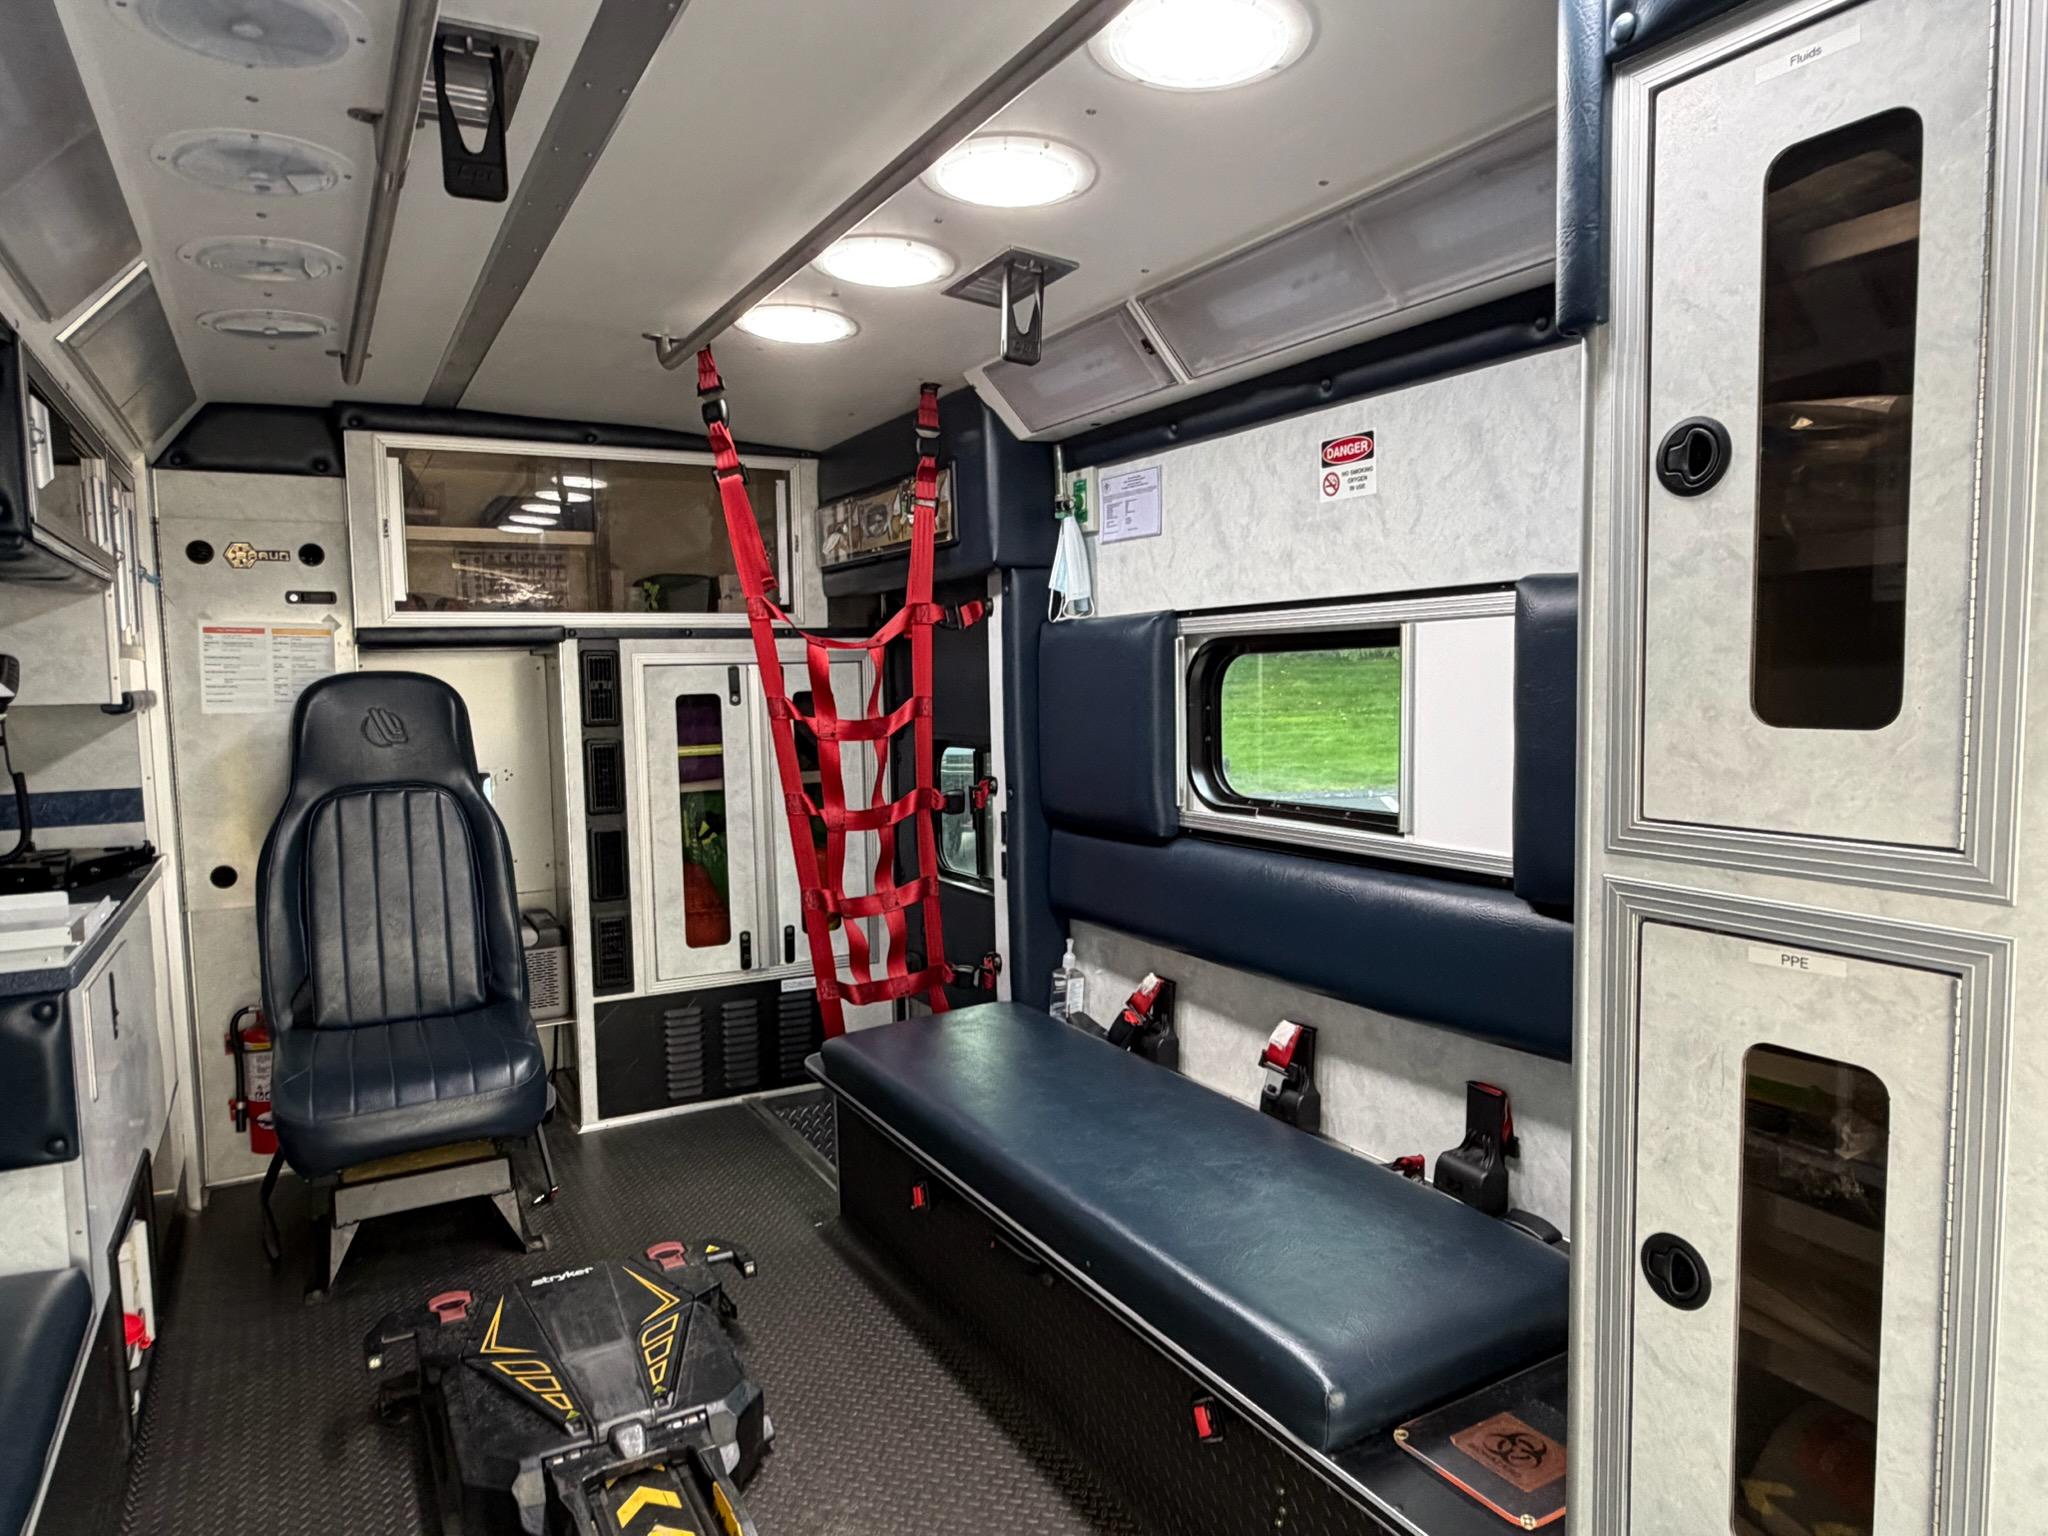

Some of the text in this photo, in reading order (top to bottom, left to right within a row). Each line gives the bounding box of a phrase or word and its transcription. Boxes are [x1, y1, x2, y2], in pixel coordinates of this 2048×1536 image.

[1790, 46, 1823, 67] Fluids
[1326, 440, 1369, 460] DANGER
[1350, 465, 1374, 476] SMOKING
[1781, 953, 1809, 970] PPE
[531, 1266, 594, 1287] stryker
